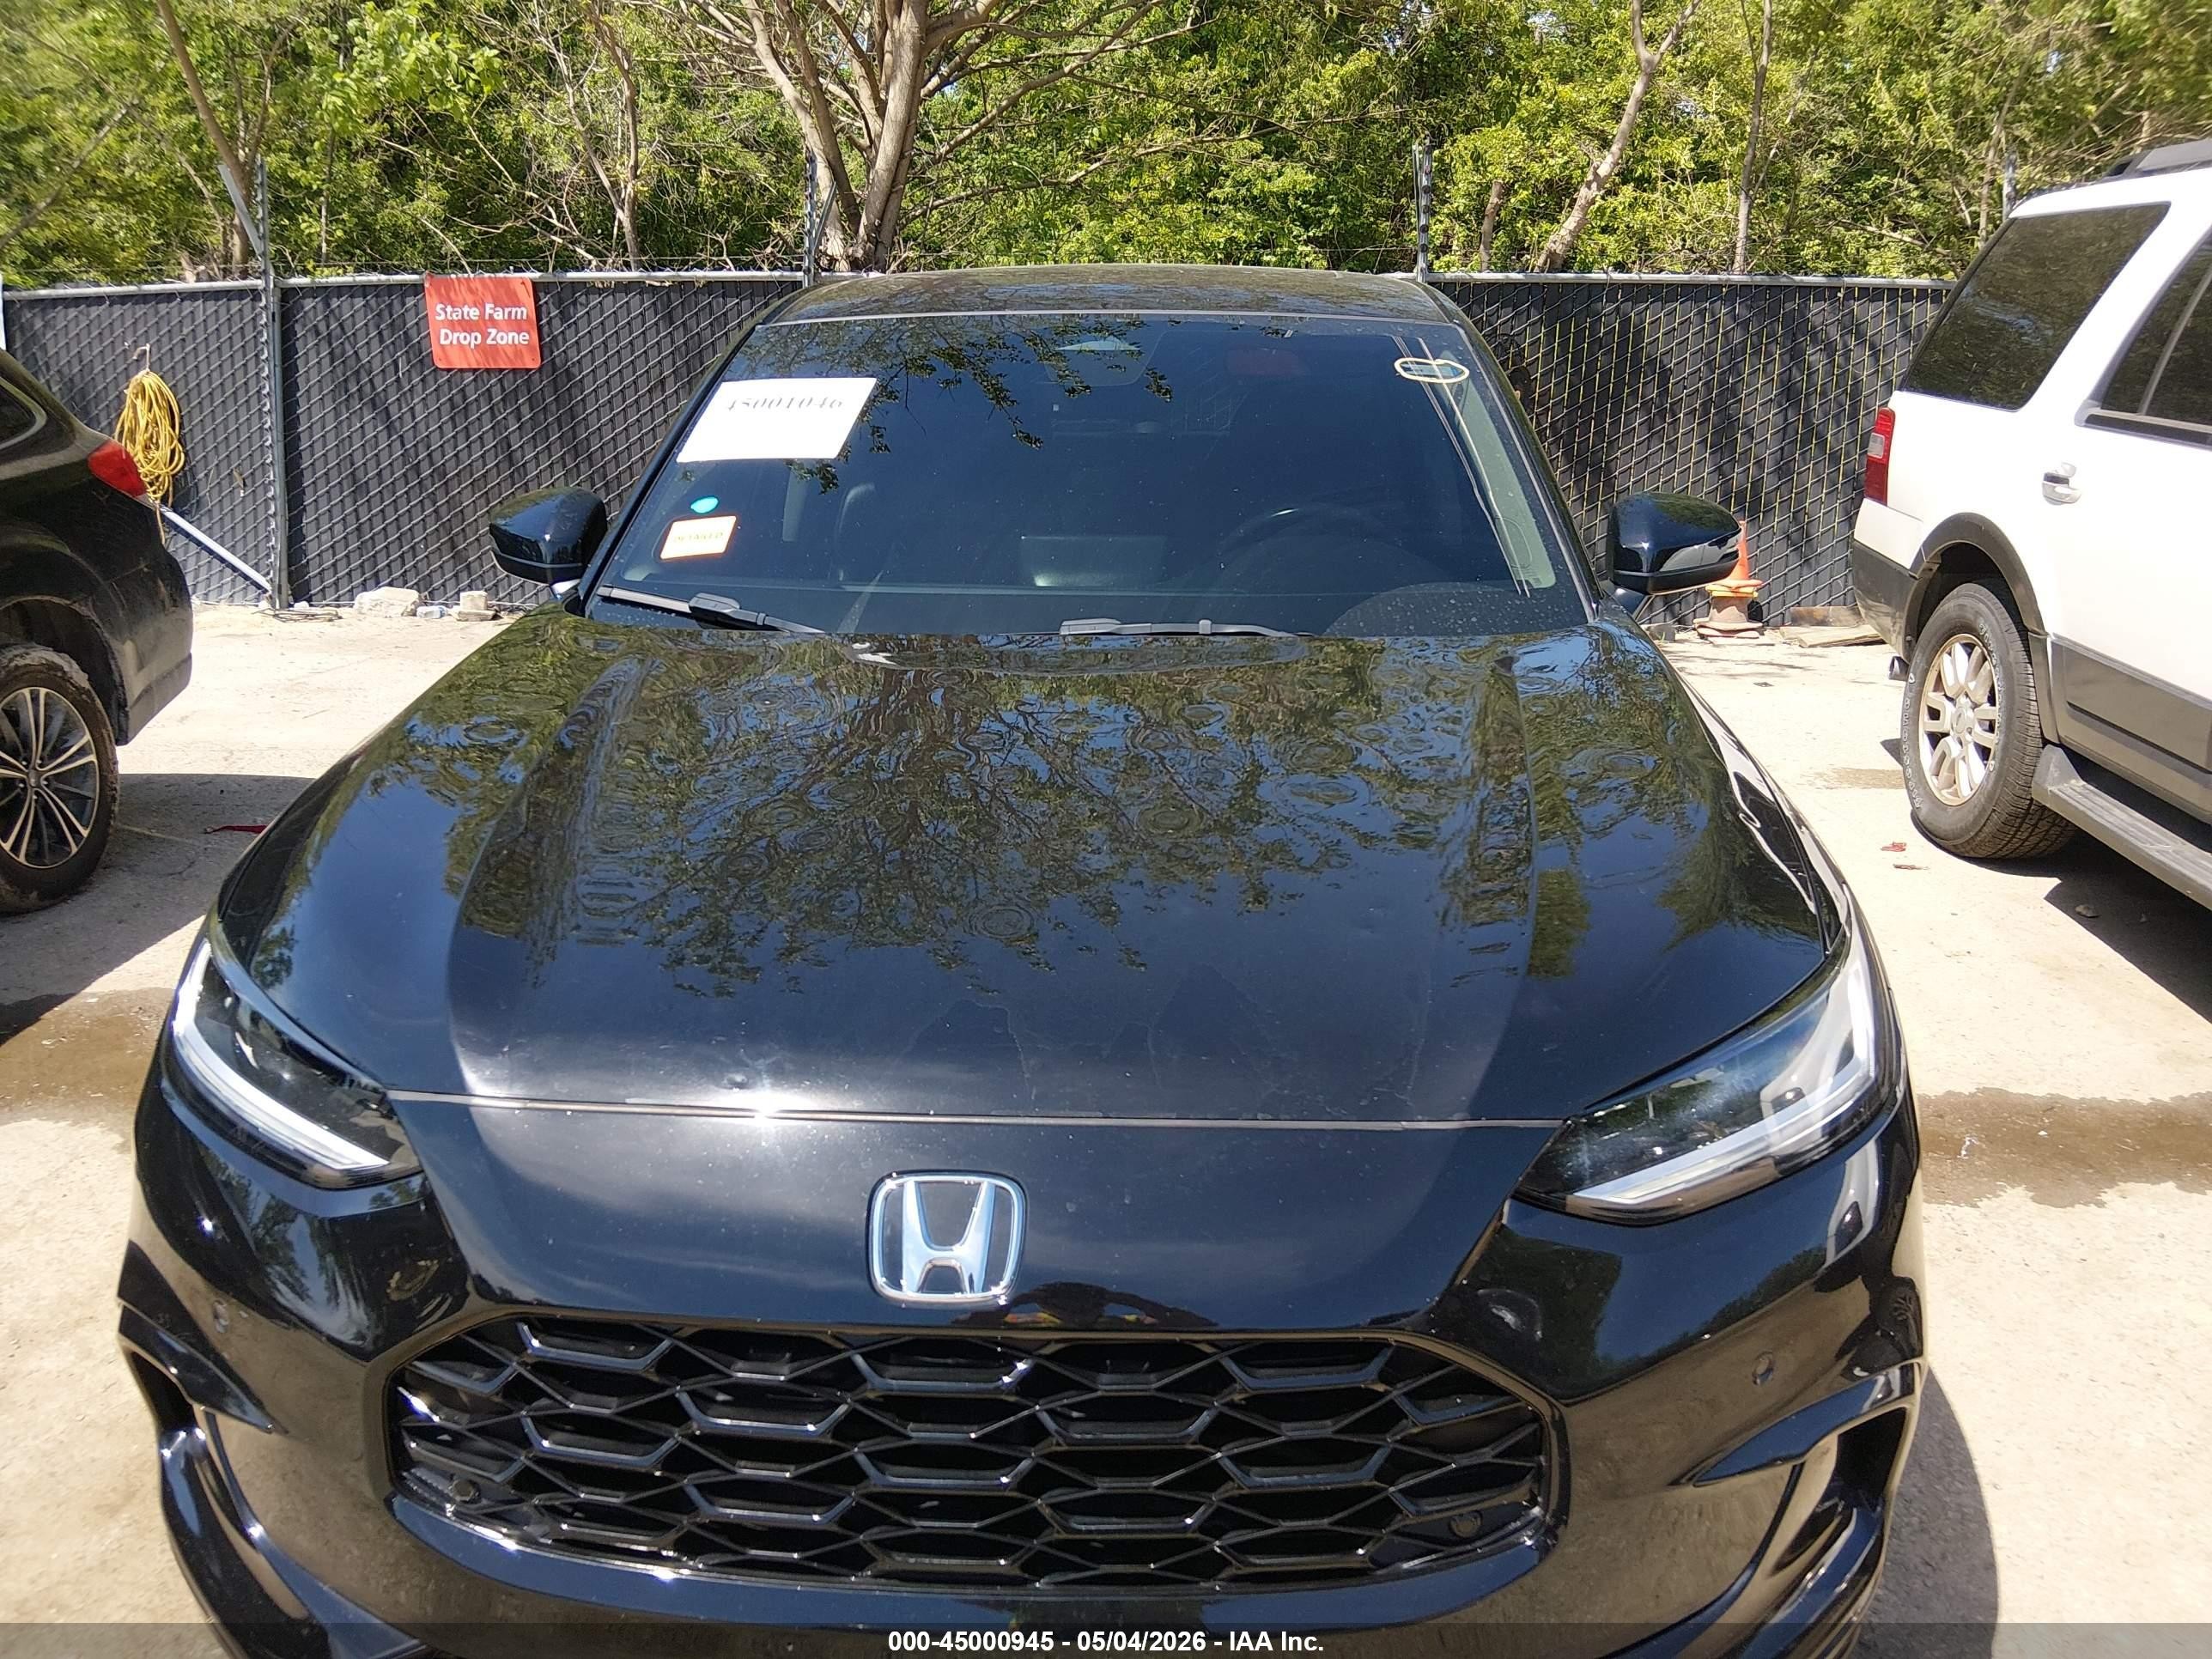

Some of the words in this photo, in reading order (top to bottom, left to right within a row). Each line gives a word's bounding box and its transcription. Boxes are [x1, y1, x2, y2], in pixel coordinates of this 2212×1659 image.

[435, 303, 480, 321] State
[485, 303, 527, 320] Farm
[440, 329, 482, 349] Drop
[487, 329, 530, 344] Zone
